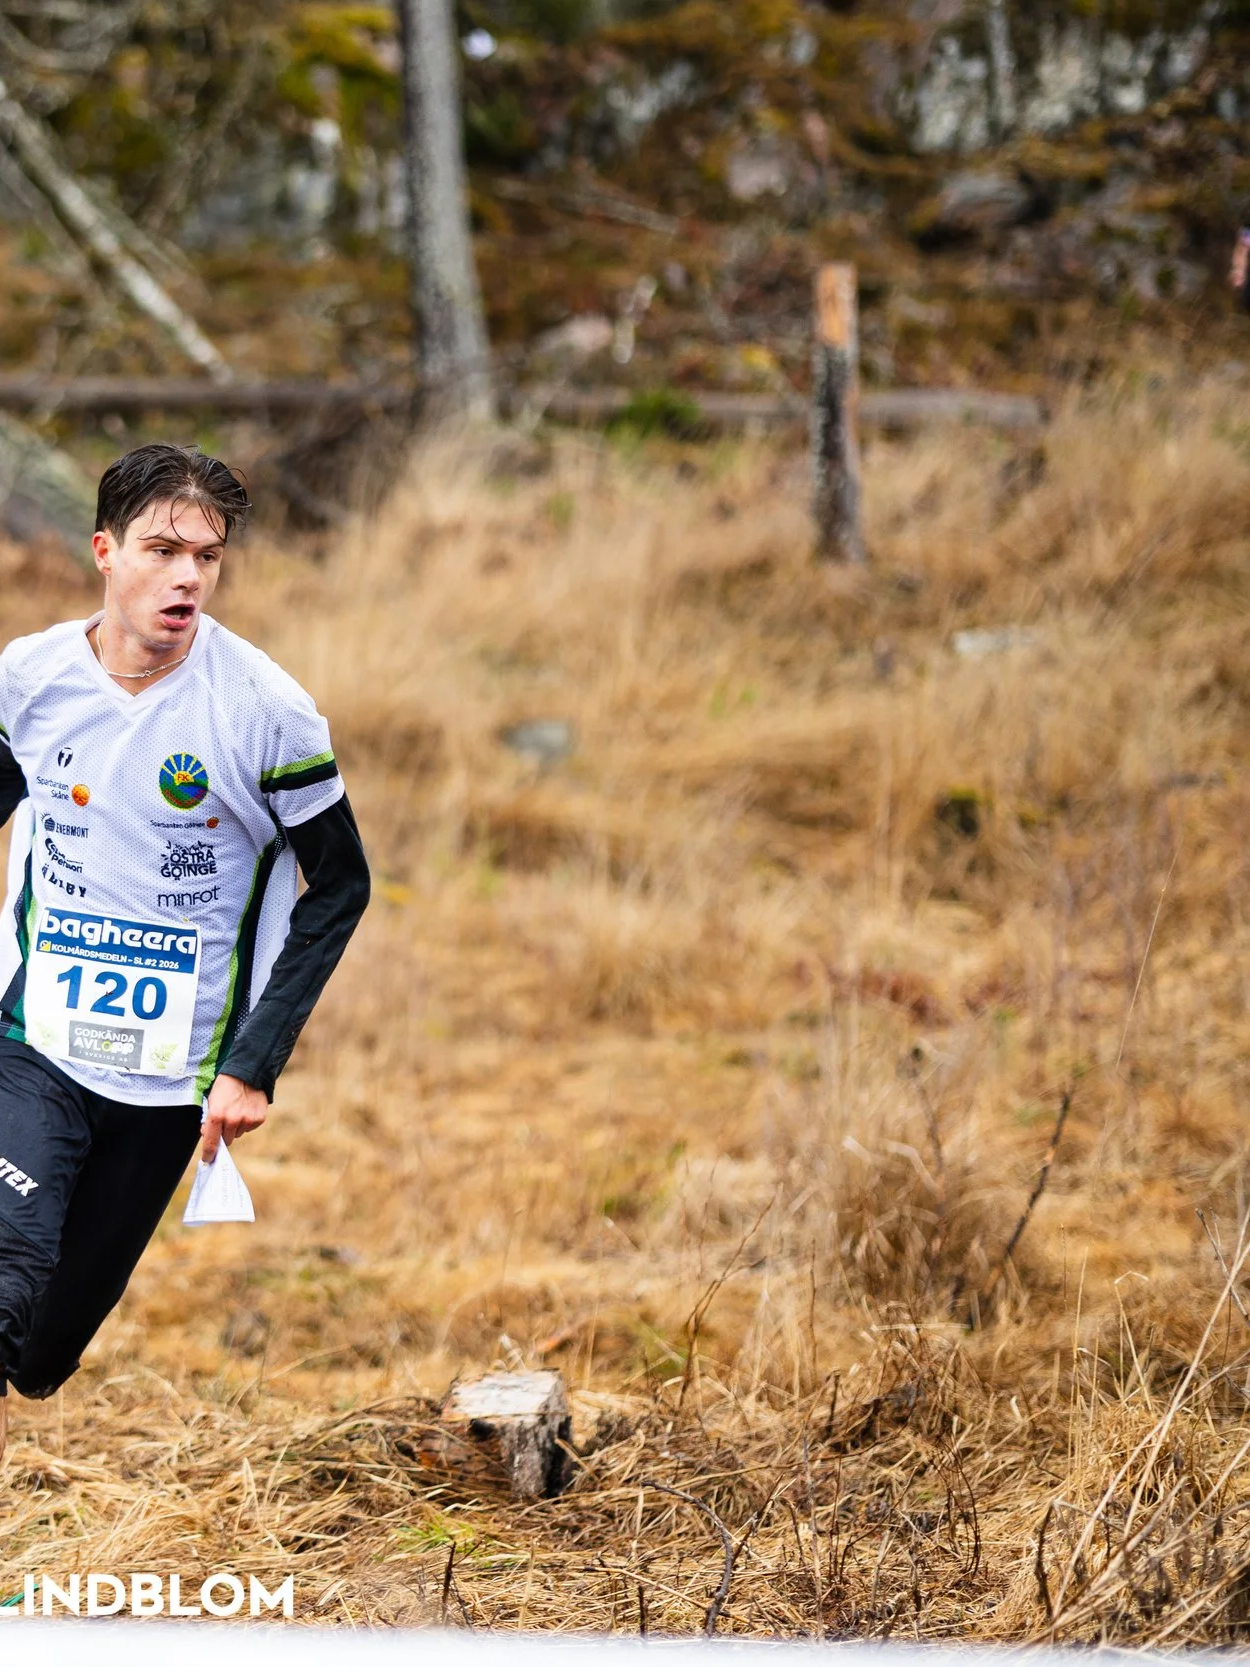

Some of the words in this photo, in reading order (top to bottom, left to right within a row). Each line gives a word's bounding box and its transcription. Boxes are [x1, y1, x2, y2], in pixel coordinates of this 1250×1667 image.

[36, 776, 69, 790] Sparbanken
[50, 789, 69, 801] Skåne
[55, 822, 89, 838] ENERMONT
[170, 849, 215, 864] ÖSTRA
[157, 885, 220, 907] minfot
[39, 909, 198, 955] bagheera
[51, 944, 127, 963] KOLMÅRDSMEDELN
[133, 956, 144, 965] SL
[144, 957, 157, 967] #2
[158, 959, 179, 970] 2026
[57, 965, 168, 1021] 120
[74, 1027, 136, 1043] GODKÄNDA
[73, 1037, 135, 1055] AVLOPP
